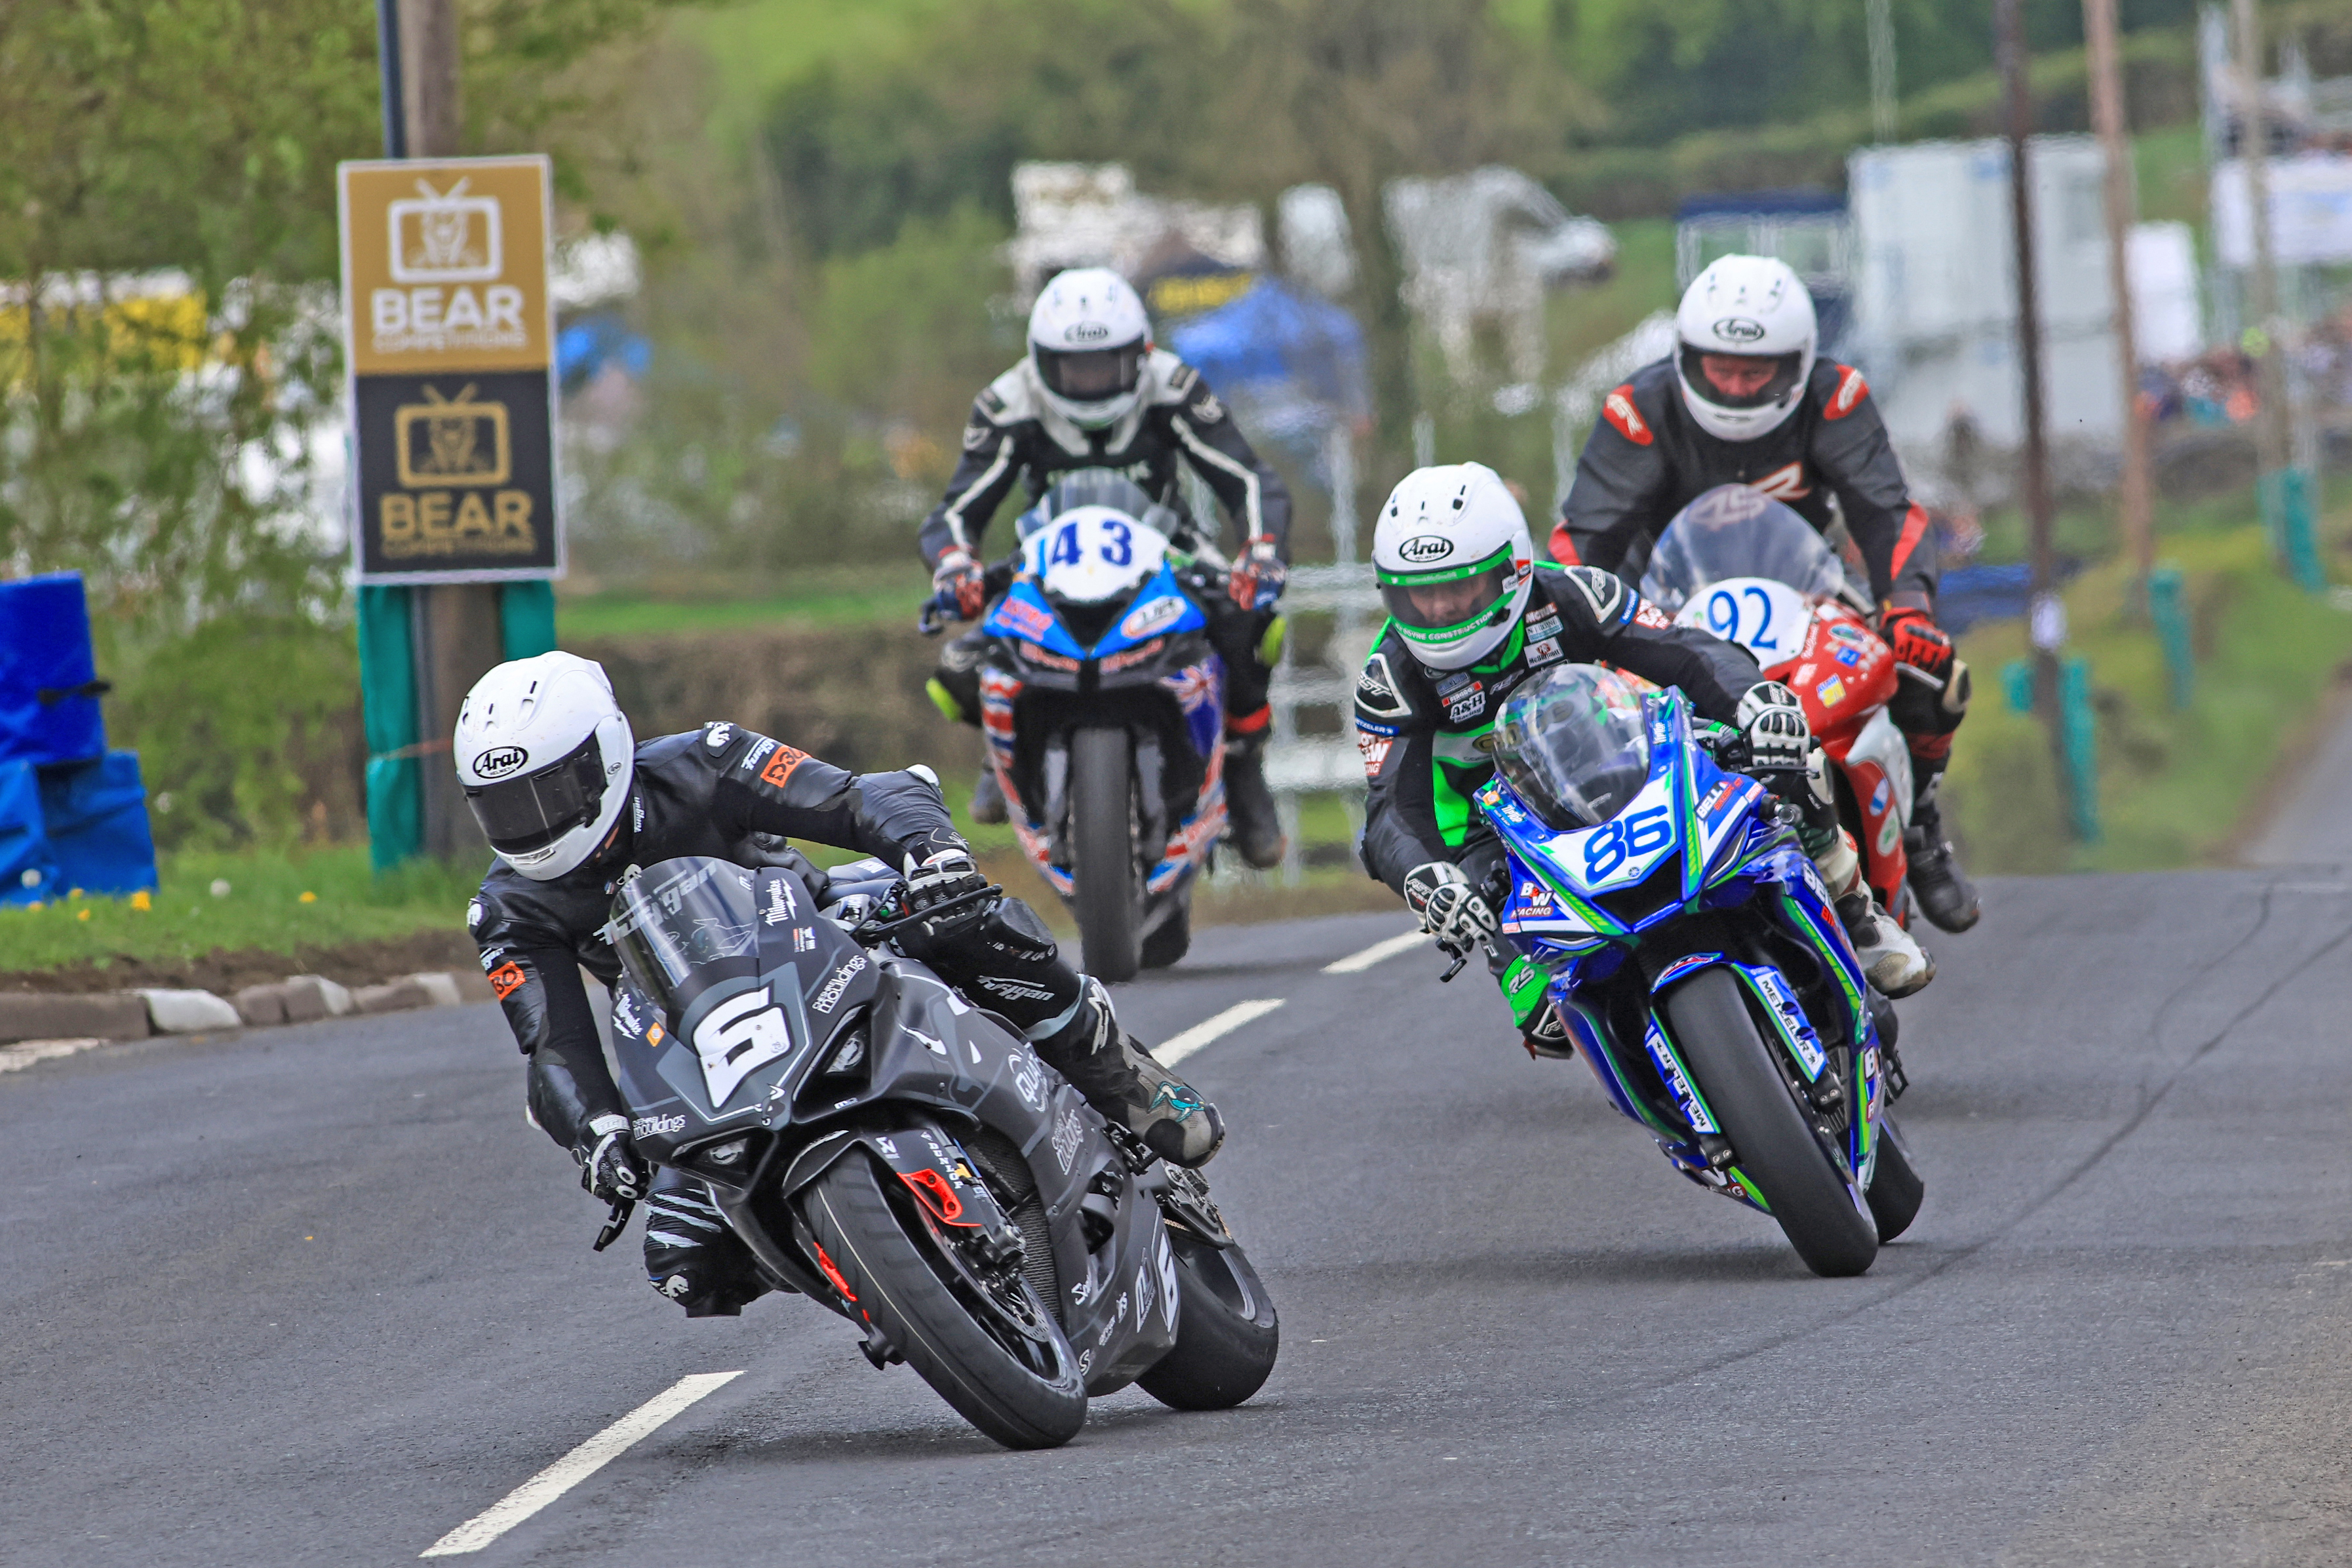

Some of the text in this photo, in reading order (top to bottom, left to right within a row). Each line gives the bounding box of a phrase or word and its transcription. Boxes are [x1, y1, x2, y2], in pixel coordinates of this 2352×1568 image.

[372, 285, 523, 331] BEAR
[380, 488, 534, 540] BEAR
[1051, 520, 1132, 567] 43
[1401, 538, 1447, 557] Arai
[1428, 610, 1495, 640] CONSTRUCTION
[1708, 587, 1778, 650] 92
[1451, 695, 1484, 718] A&H
[477, 747, 521, 773] Arai
[1696, 786, 1723, 819] BELL
[1584, 805, 1673, 886] 86
[764, 879, 789, 927] Milwaukee
[1511, 907, 1553, 918] RACING
[1520, 882, 1554, 907] B&W
[817, 954, 868, 1013] mouldings
[928, 1143, 964, 1189] DUNLOP
